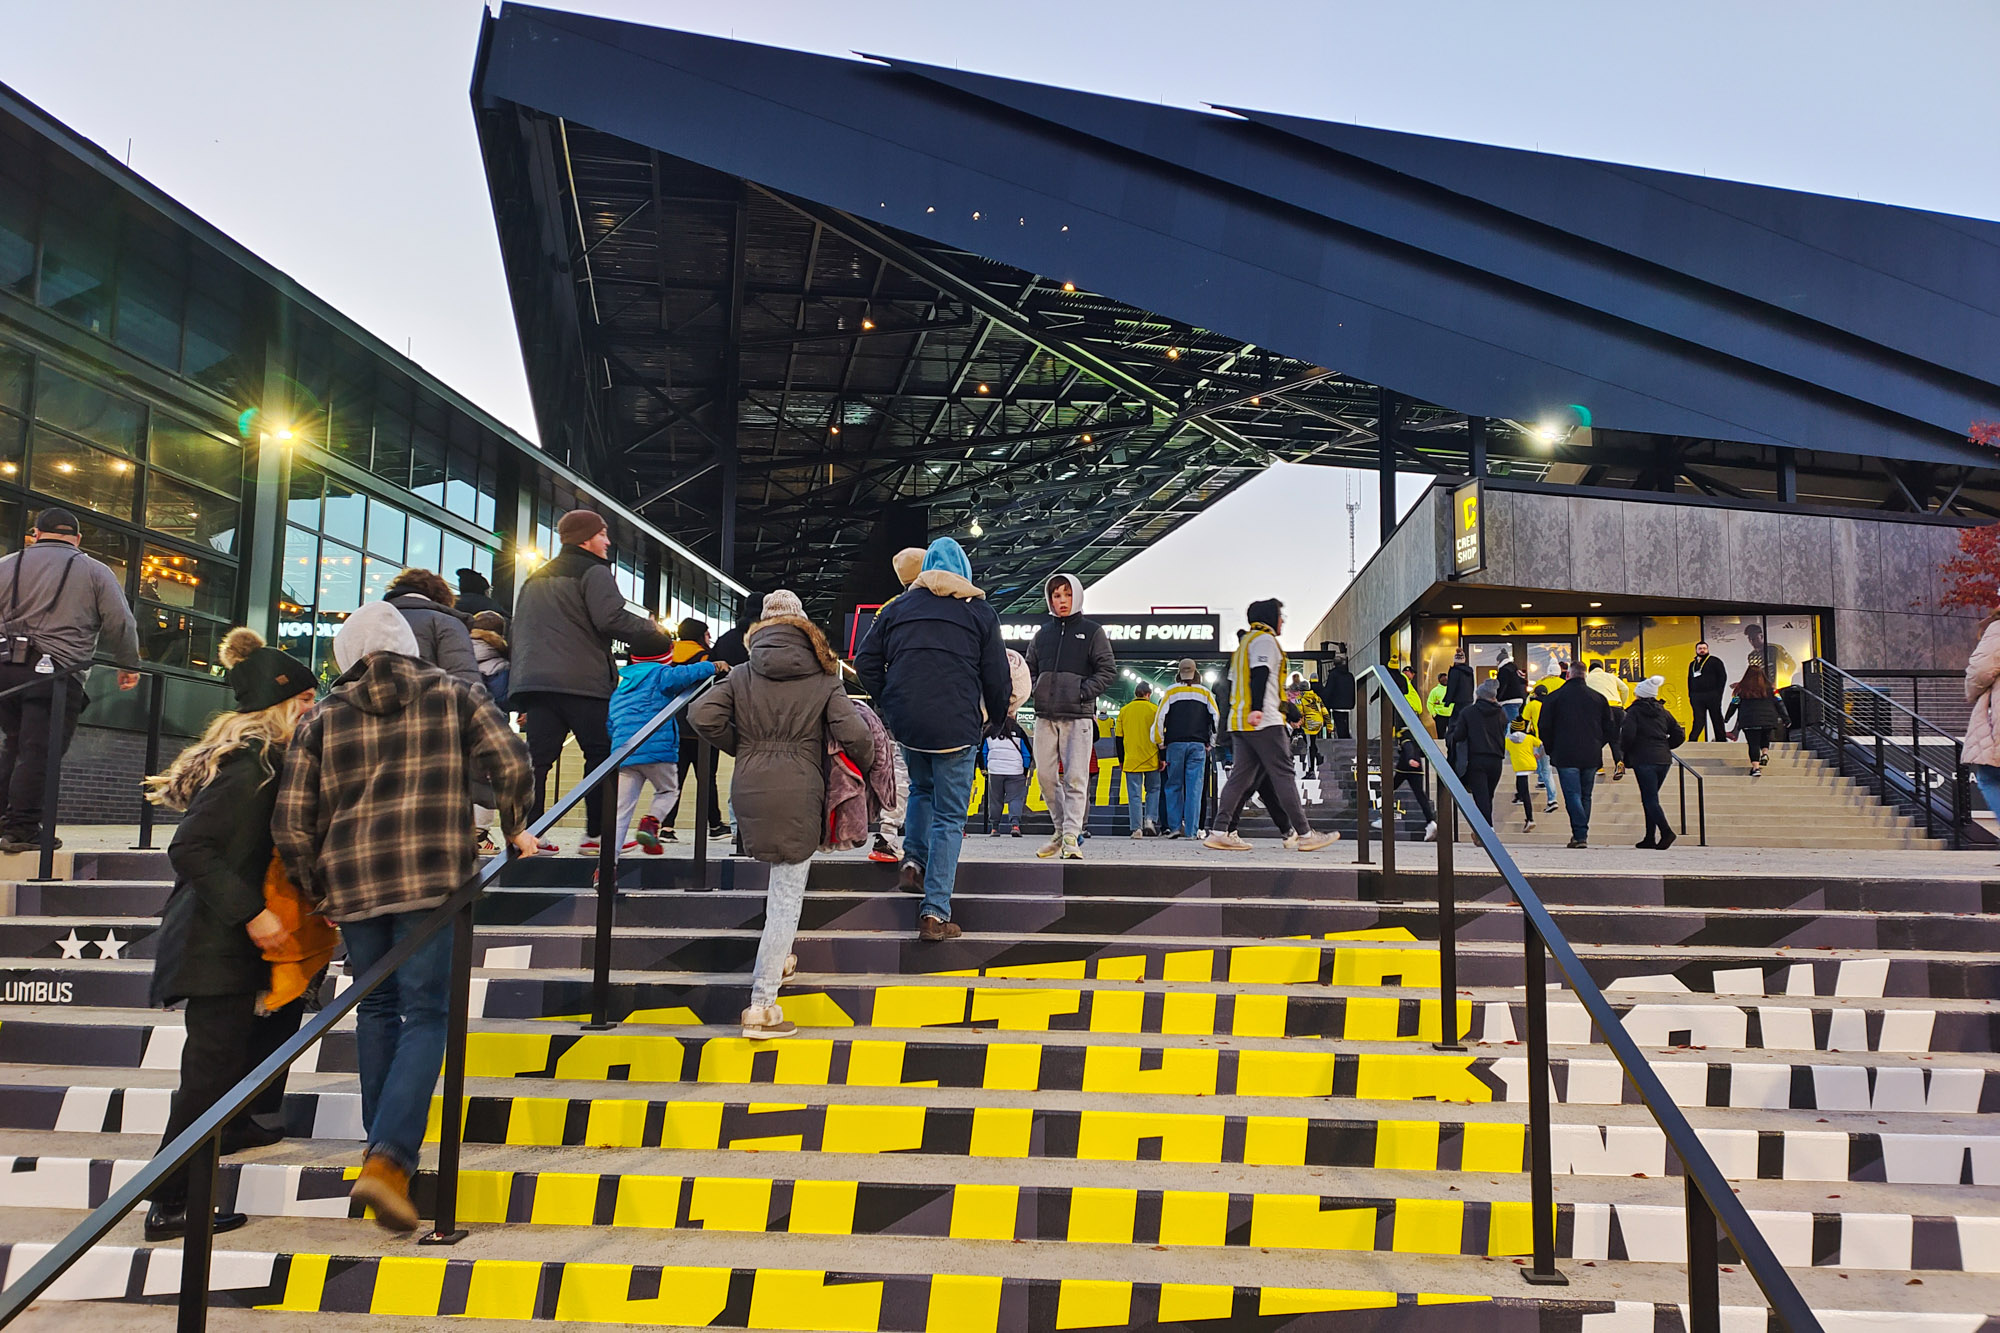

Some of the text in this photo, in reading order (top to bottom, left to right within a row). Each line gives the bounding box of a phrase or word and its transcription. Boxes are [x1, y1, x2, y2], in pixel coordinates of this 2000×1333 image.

[1457, 547, 1477, 564] SHOP
[1101, 624, 1141, 640] TRIC
[1145, 624, 1214, 640] POWER
